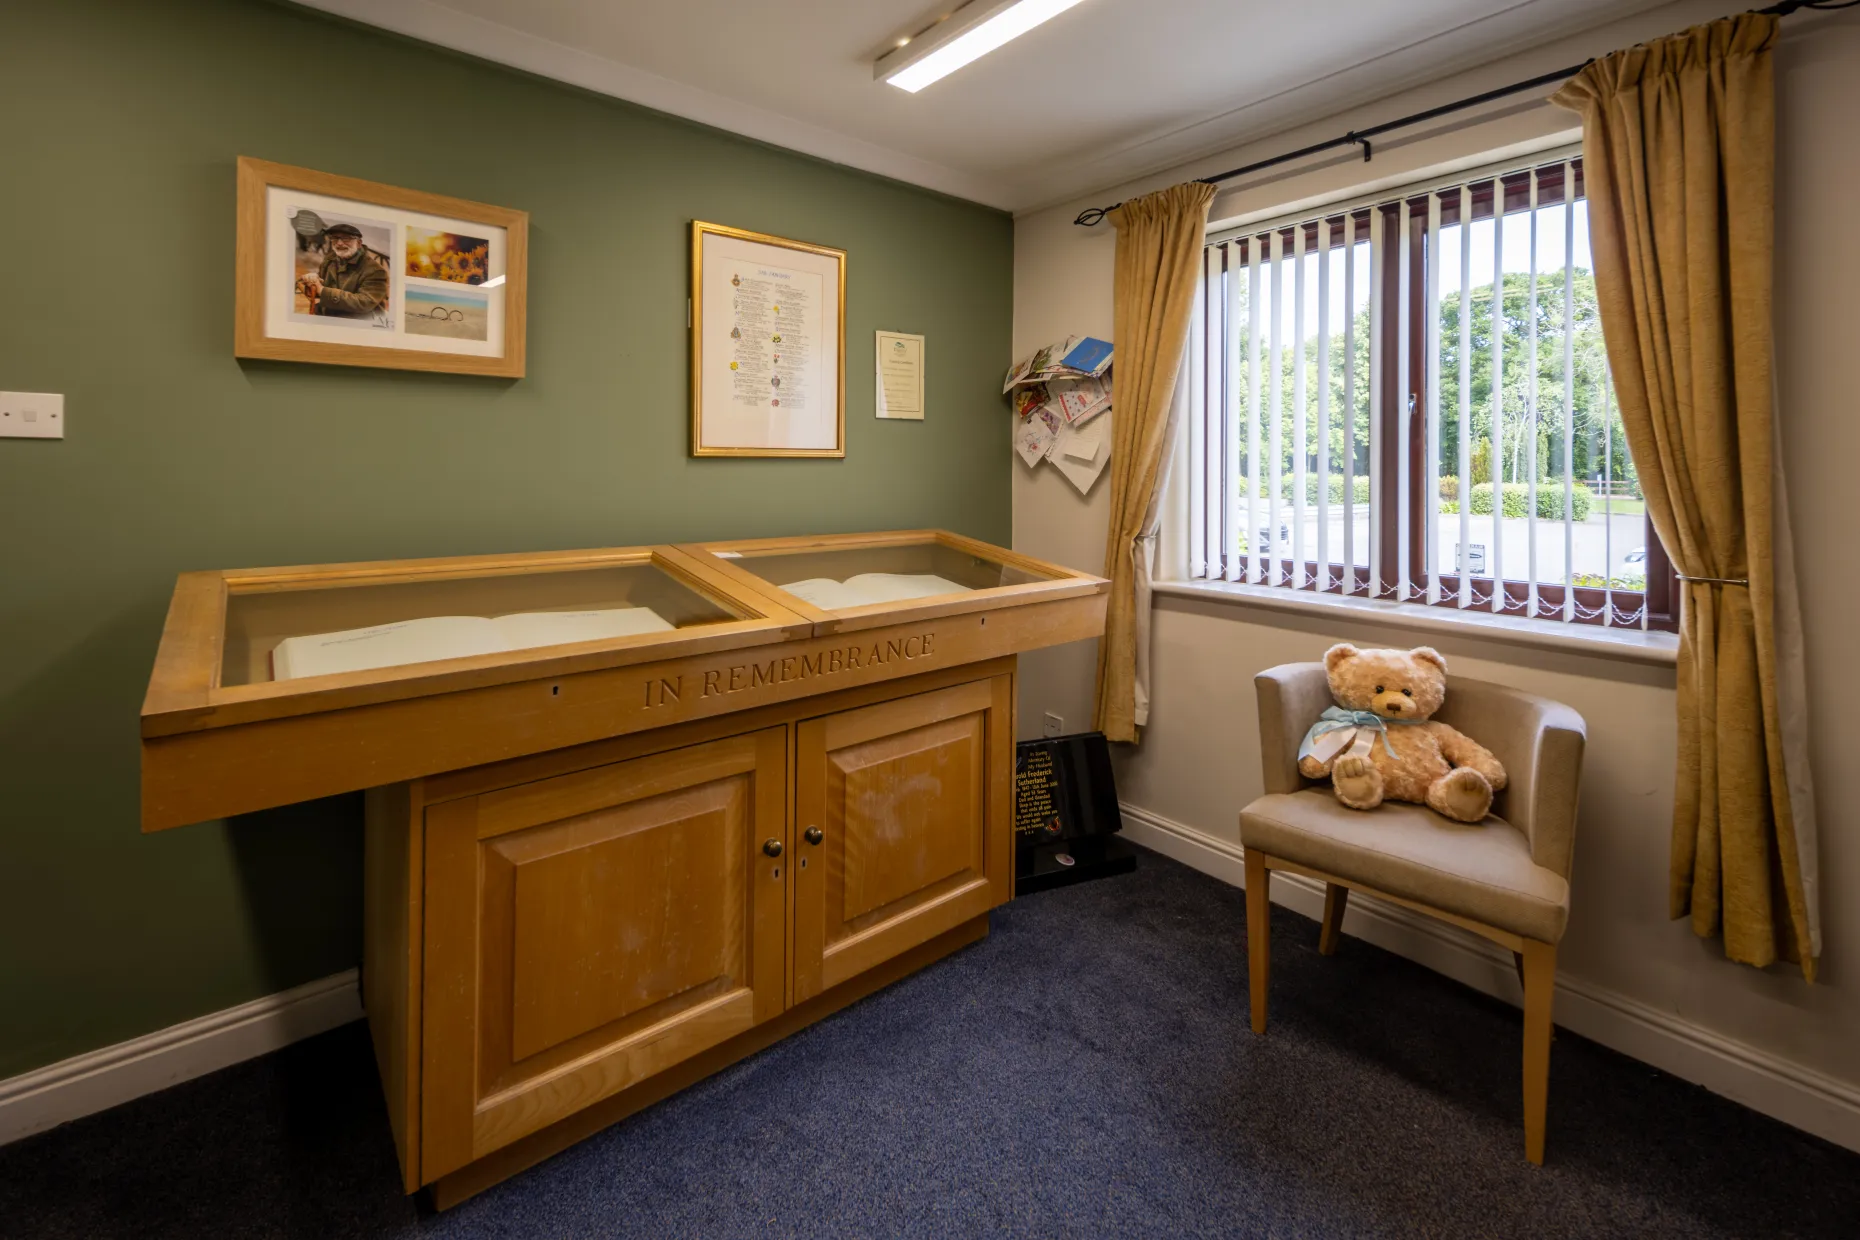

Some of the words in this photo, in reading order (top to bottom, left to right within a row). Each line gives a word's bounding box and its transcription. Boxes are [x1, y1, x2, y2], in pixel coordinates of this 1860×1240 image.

[642, 675, 683, 710] IN
[700, 632, 936, 699] REMEMBRANCE
[1018, 776, 1046, 786] Sutherland
